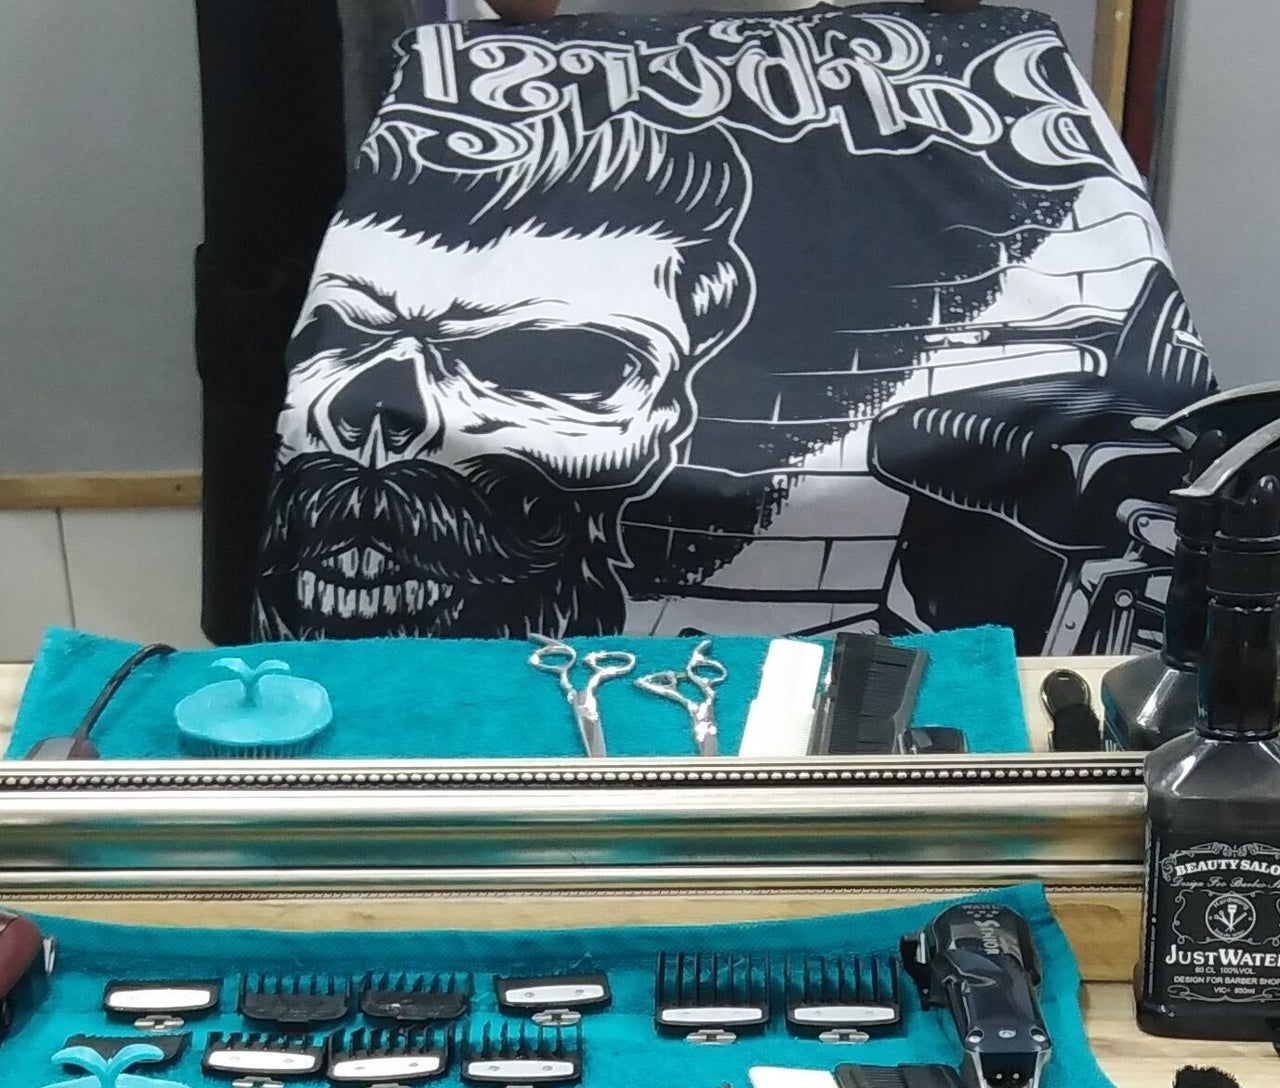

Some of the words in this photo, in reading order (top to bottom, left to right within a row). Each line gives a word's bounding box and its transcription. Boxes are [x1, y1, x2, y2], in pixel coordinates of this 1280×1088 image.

[1173, 975, 1205, 984] DESIGN
[1205, 976, 1224, 984] FOR
[1224, 976, 1258, 985] BARBER
